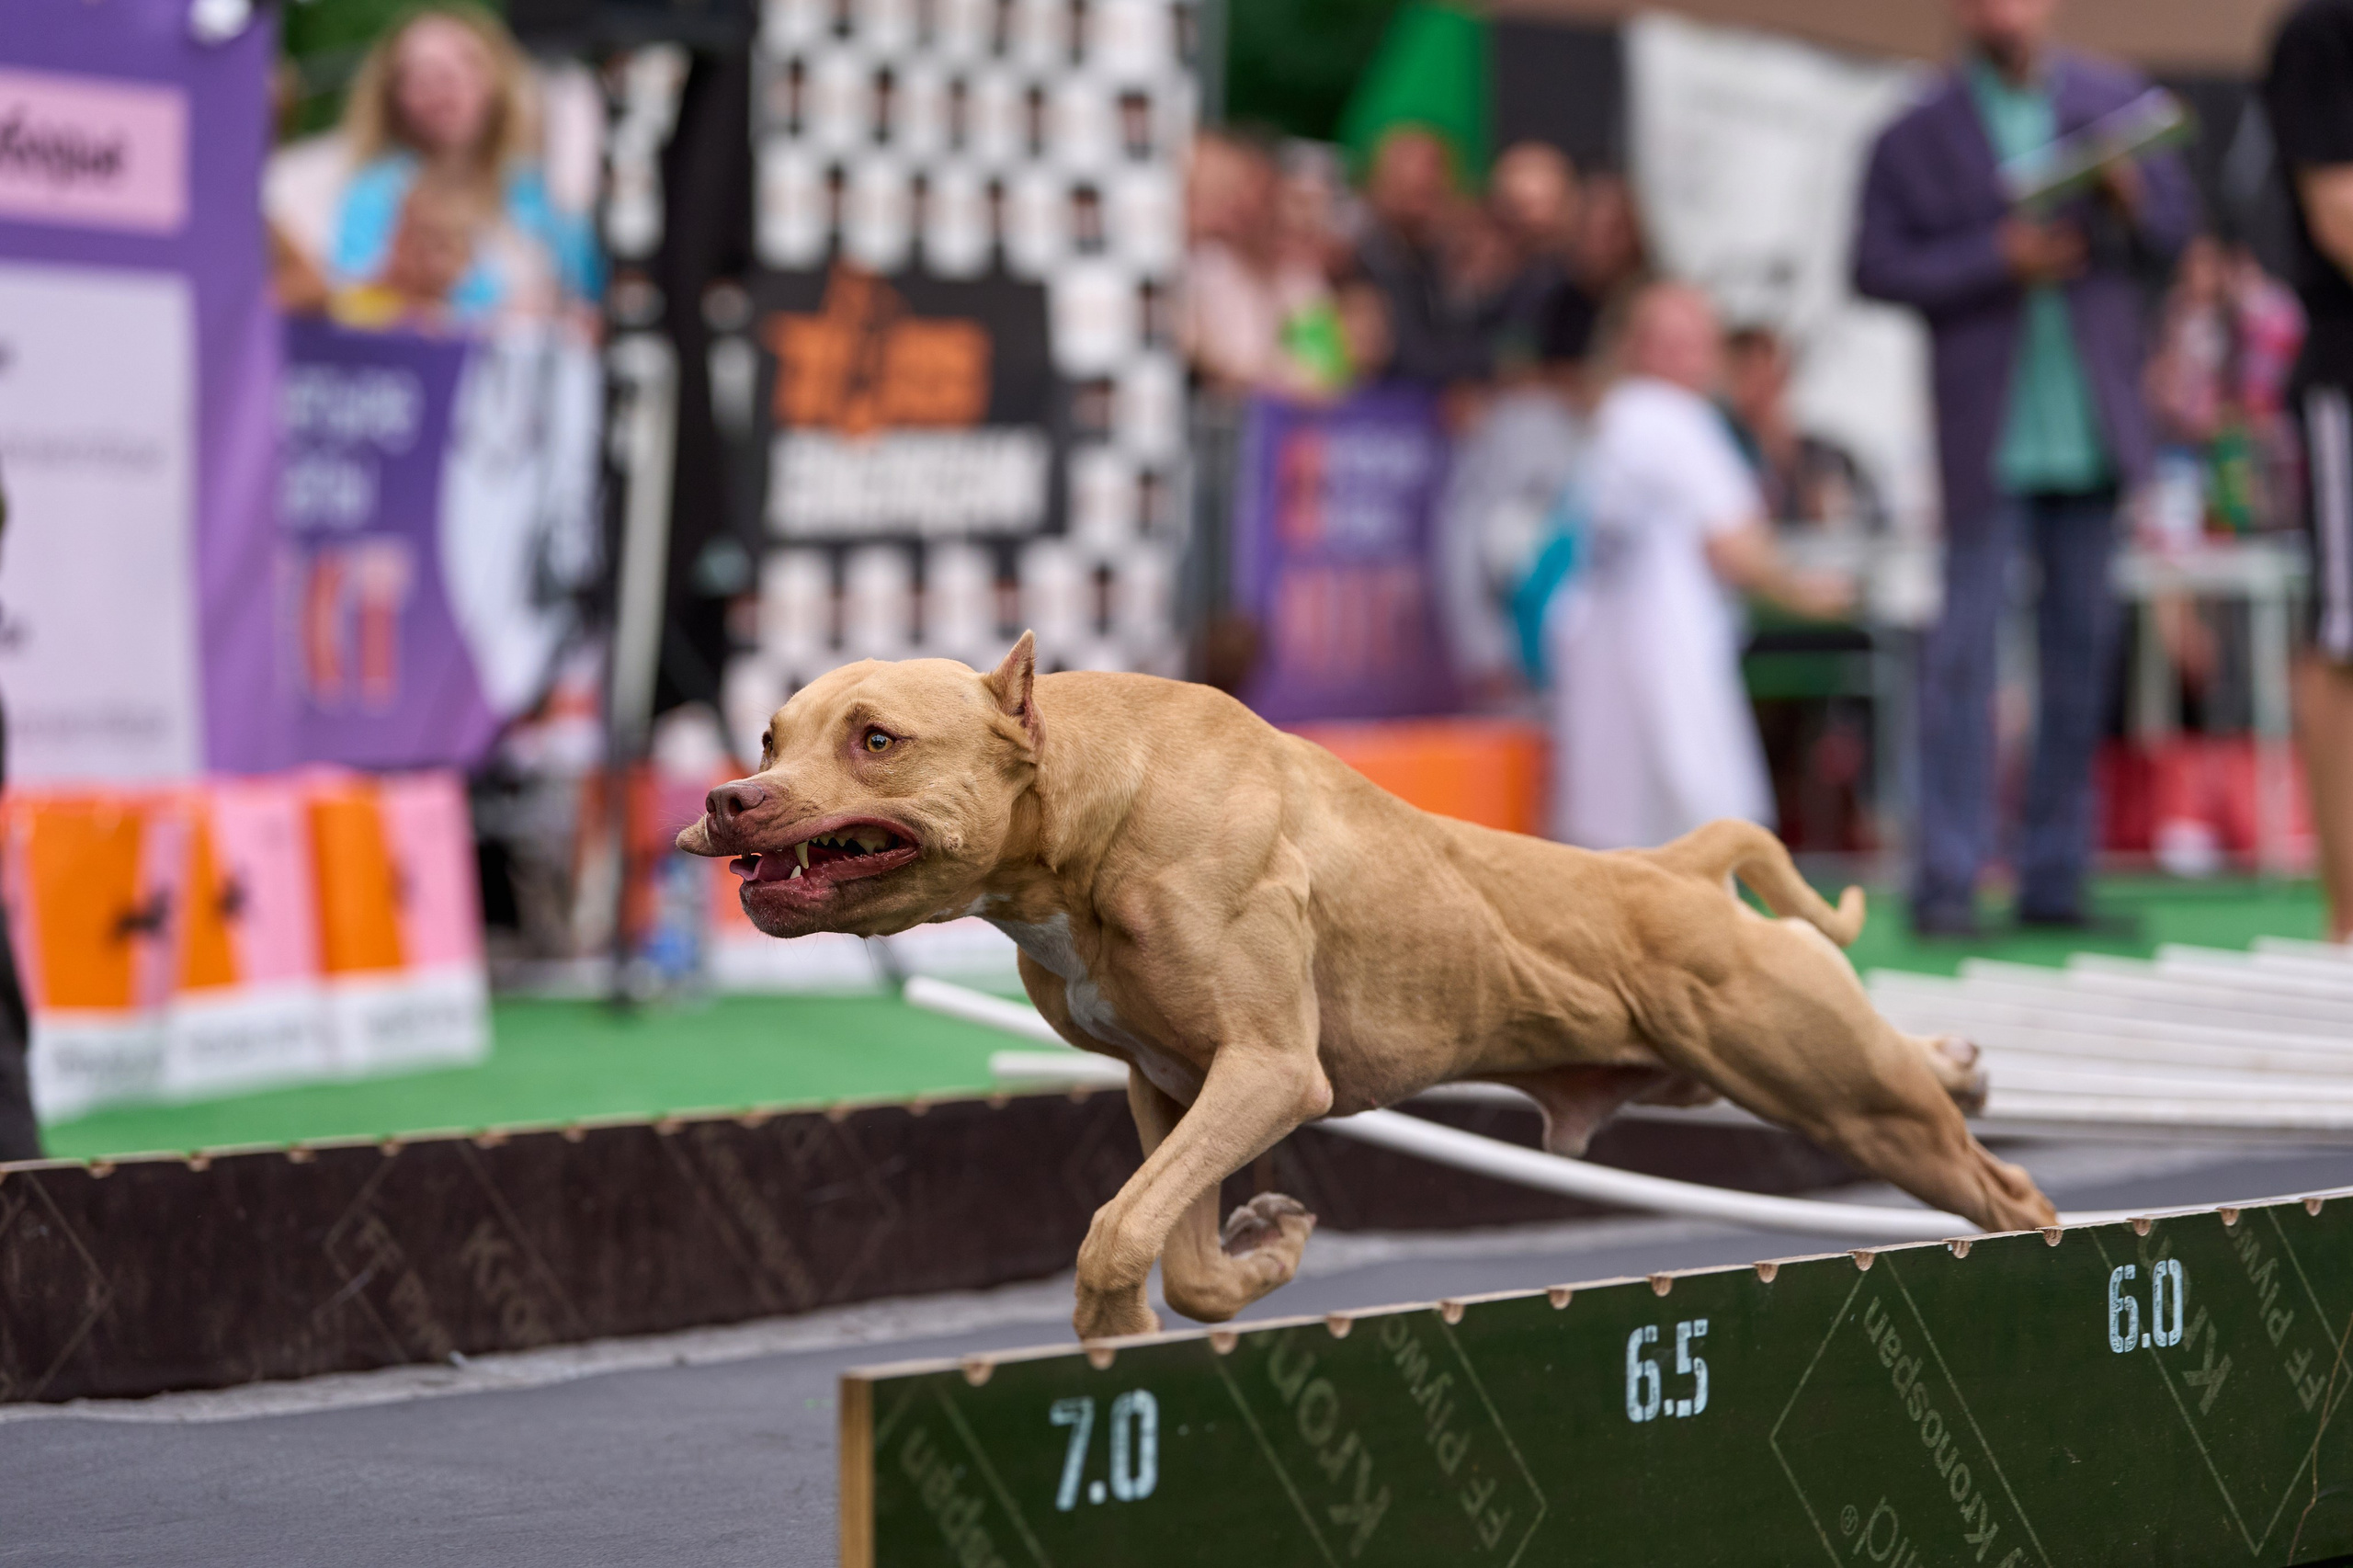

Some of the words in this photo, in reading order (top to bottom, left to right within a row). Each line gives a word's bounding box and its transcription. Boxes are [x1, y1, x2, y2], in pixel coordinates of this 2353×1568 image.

[2108, 1257, 2185, 1355] 6.0
[1624, 1318, 1709, 1424] 6.5
[2283, 1346, 2328, 1415] FF
[1049, 1387, 1160, 1512] 7.0
[1863, 1296, 2000, 1562] Kronospan
[1461, 1477, 1513, 1551] FF
